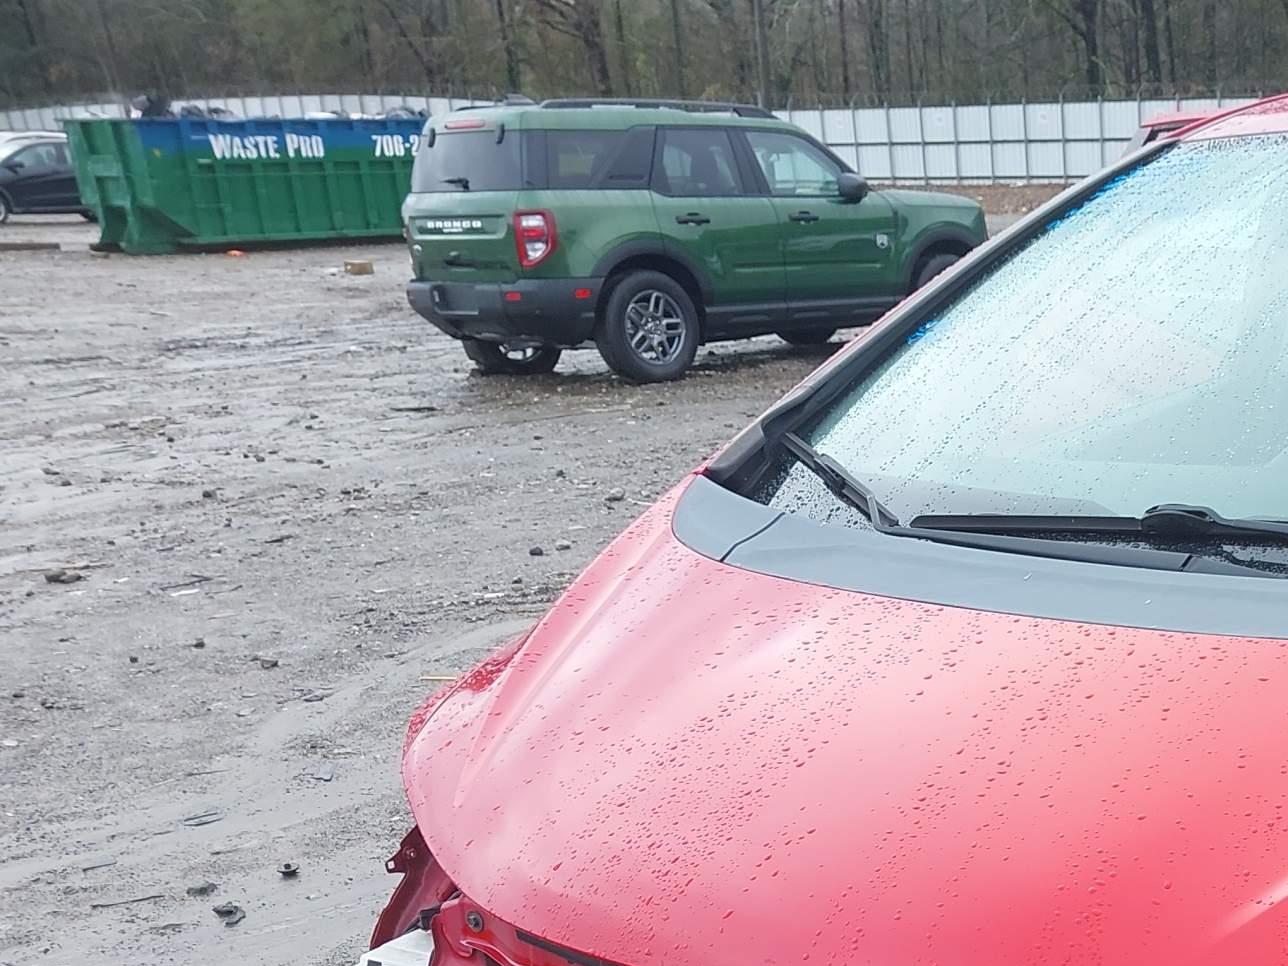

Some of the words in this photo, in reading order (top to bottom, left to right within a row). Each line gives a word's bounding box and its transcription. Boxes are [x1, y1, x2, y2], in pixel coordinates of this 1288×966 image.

[207, 133, 280, 160] WASTE
[285, 133, 325, 159] PRO
[427, 220, 482, 229] BRONCO
